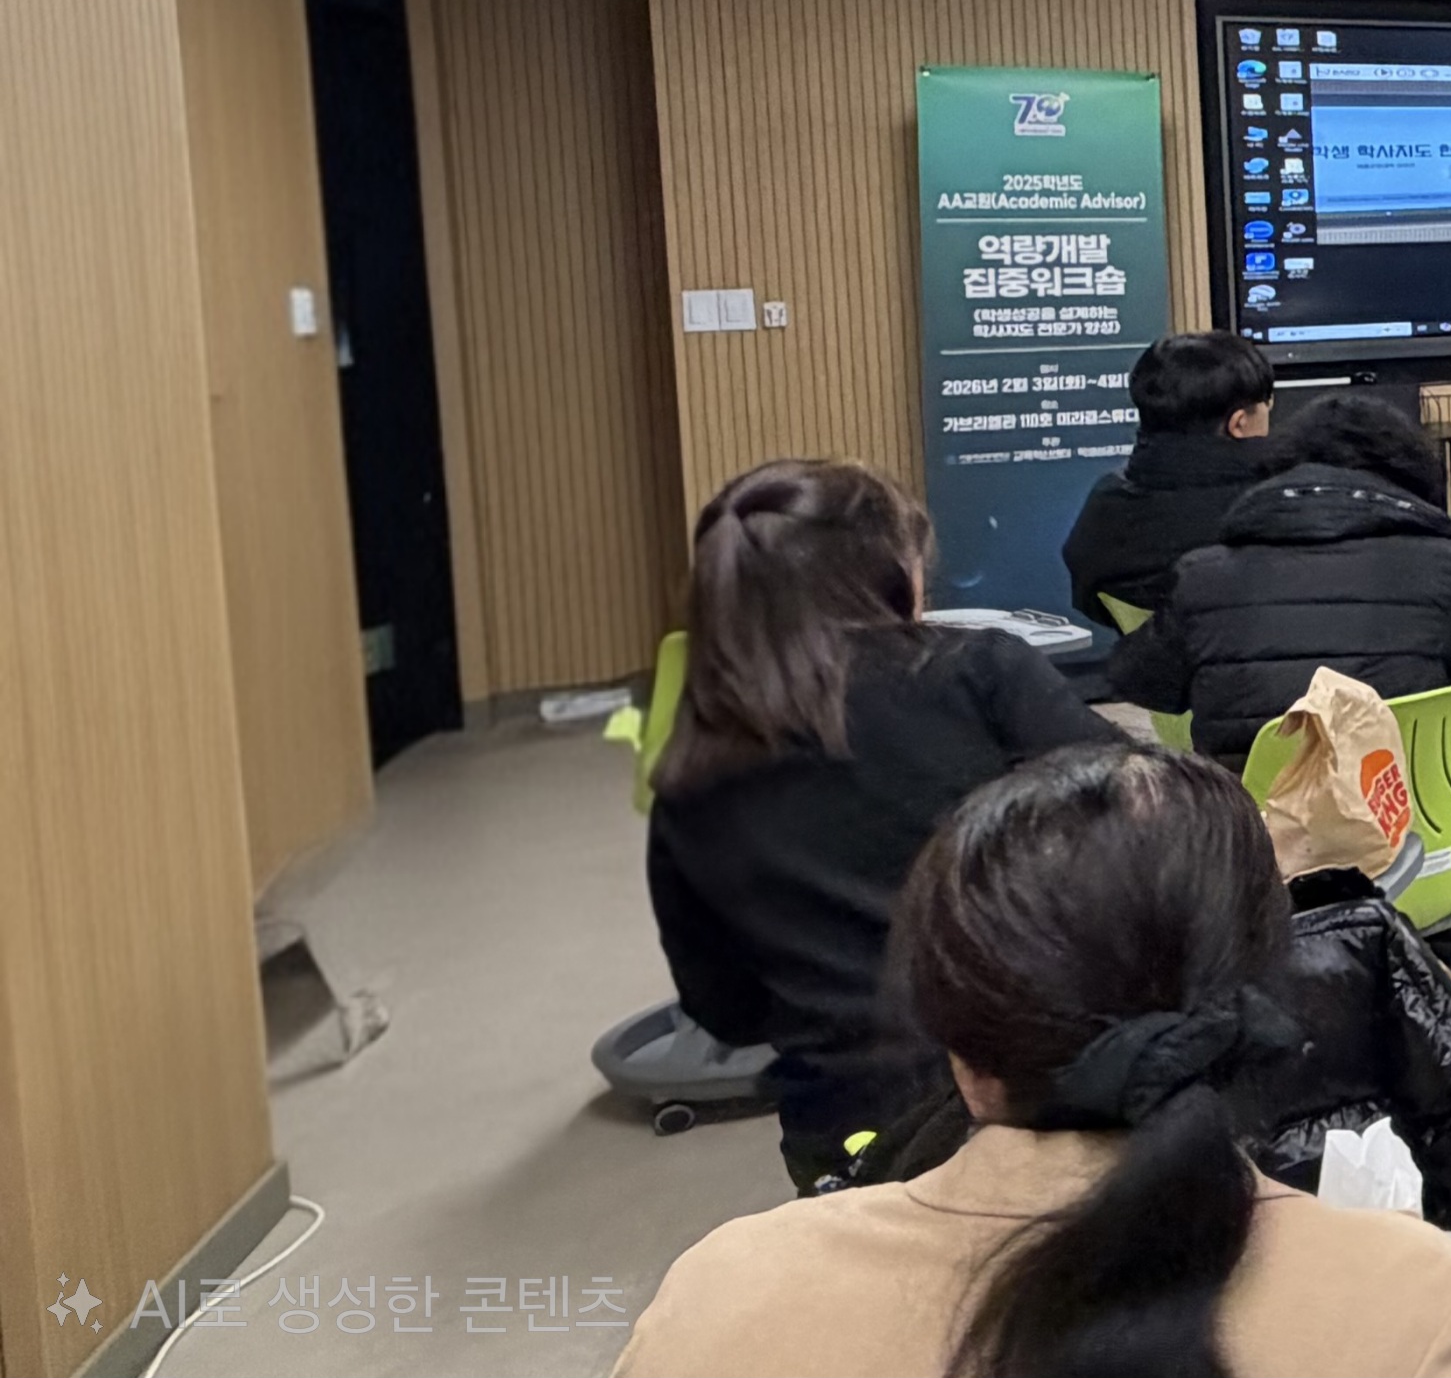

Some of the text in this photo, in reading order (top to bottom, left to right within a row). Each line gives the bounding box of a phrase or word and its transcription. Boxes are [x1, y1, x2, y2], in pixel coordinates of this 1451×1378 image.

[1357, 144, 1433, 159] 학사지도
[1003, 174, 1083, 191] 2025학년도
[938, 192, 1147, 210] AA교원(Academic Advisor)
[978, 234, 1112, 265] 역량개발
[963, 265, 1127, 299] 집중워크숍
[1059, 305, 1119, 321] 설계하는
[941, 372, 1129, 395] 2026년 2월 3일(화)~4일(
[1019, 412, 1053, 428] 110호
[1056, 407, 1140, 426] 미라클스튜디
